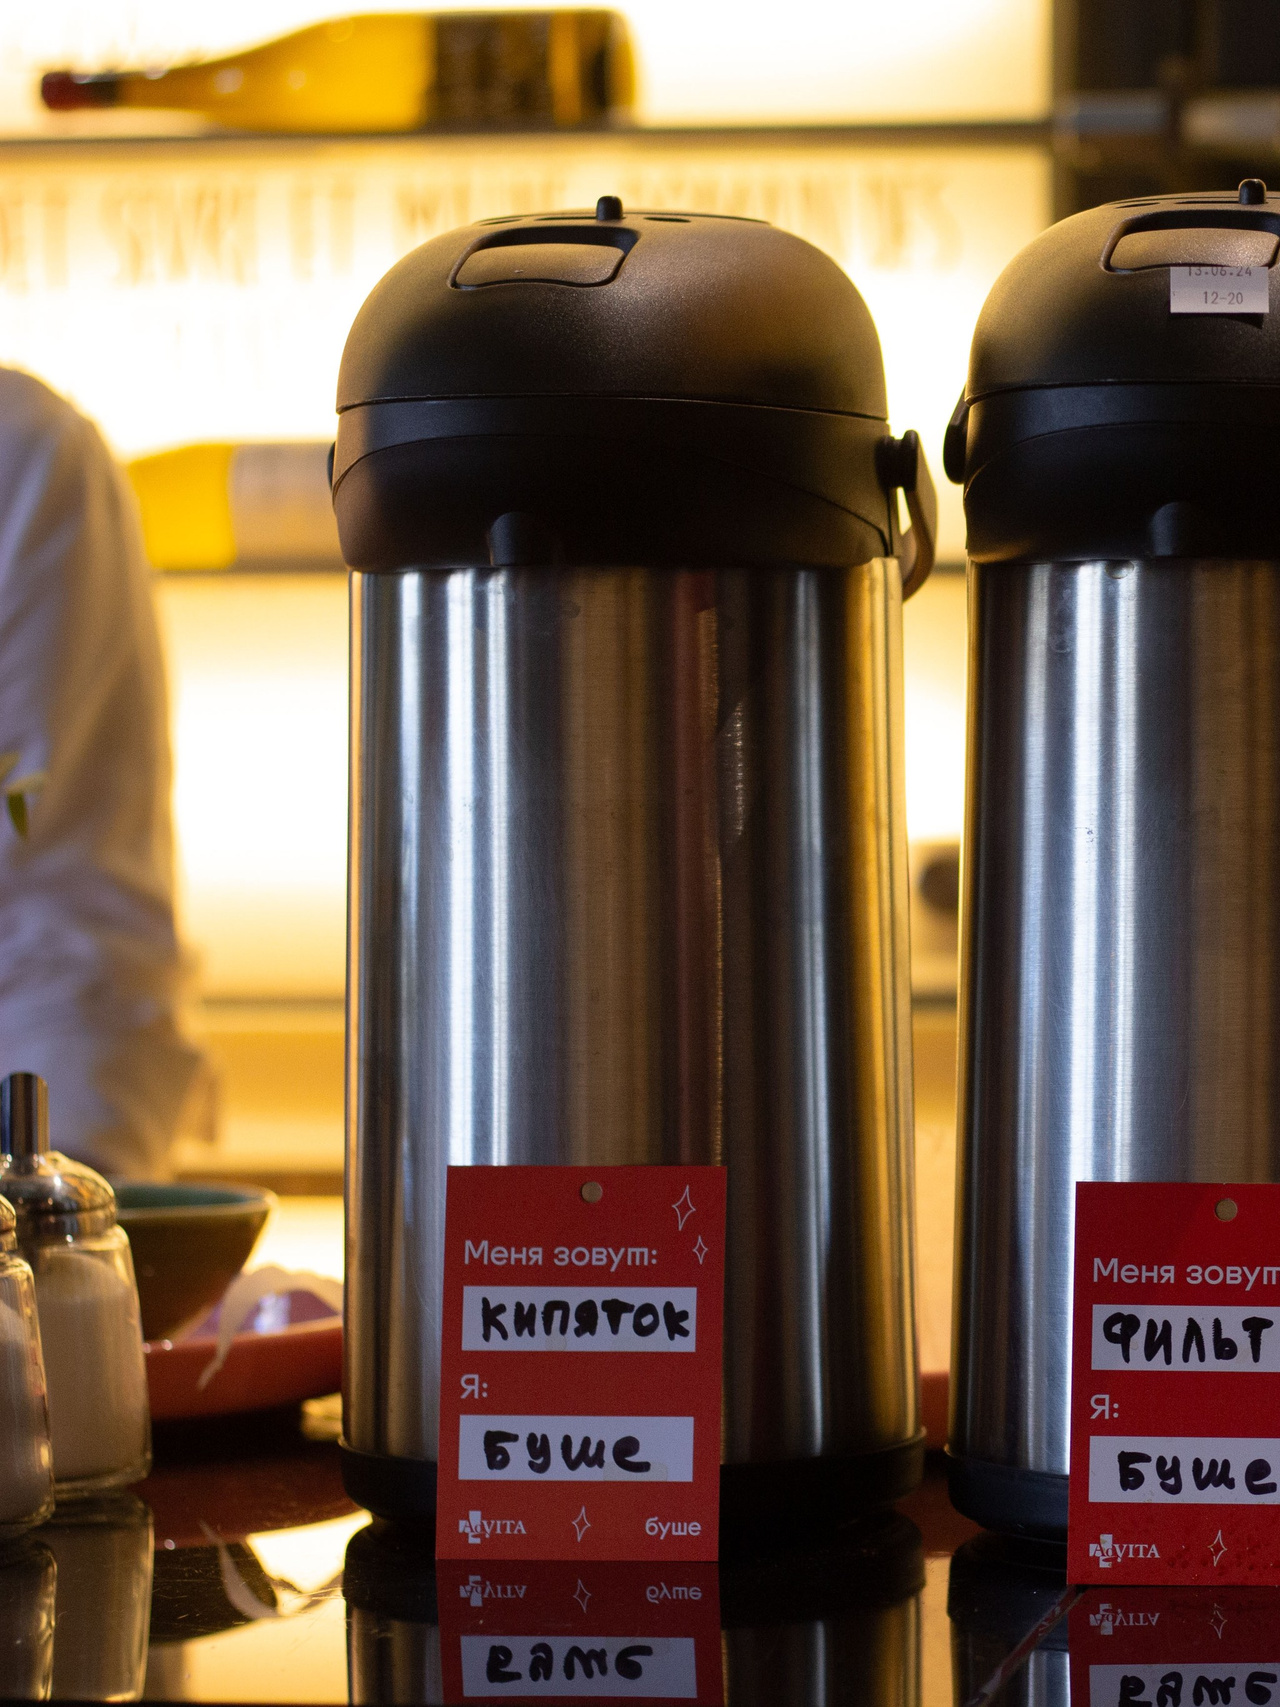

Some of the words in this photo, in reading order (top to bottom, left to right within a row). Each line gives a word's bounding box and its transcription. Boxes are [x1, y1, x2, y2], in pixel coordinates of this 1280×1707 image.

[1203, 290, 1244, 305] 12-20
[465, 1240, 542, 1265] Меня
[554, 1247, 657, 1272] зовут:
[1094, 1258, 1174, 1283] Меня
[461, 1374, 487, 1399] Я:
[1090, 1394, 1119, 1419] Я:
[645, 1517, 701, 1540] буше
